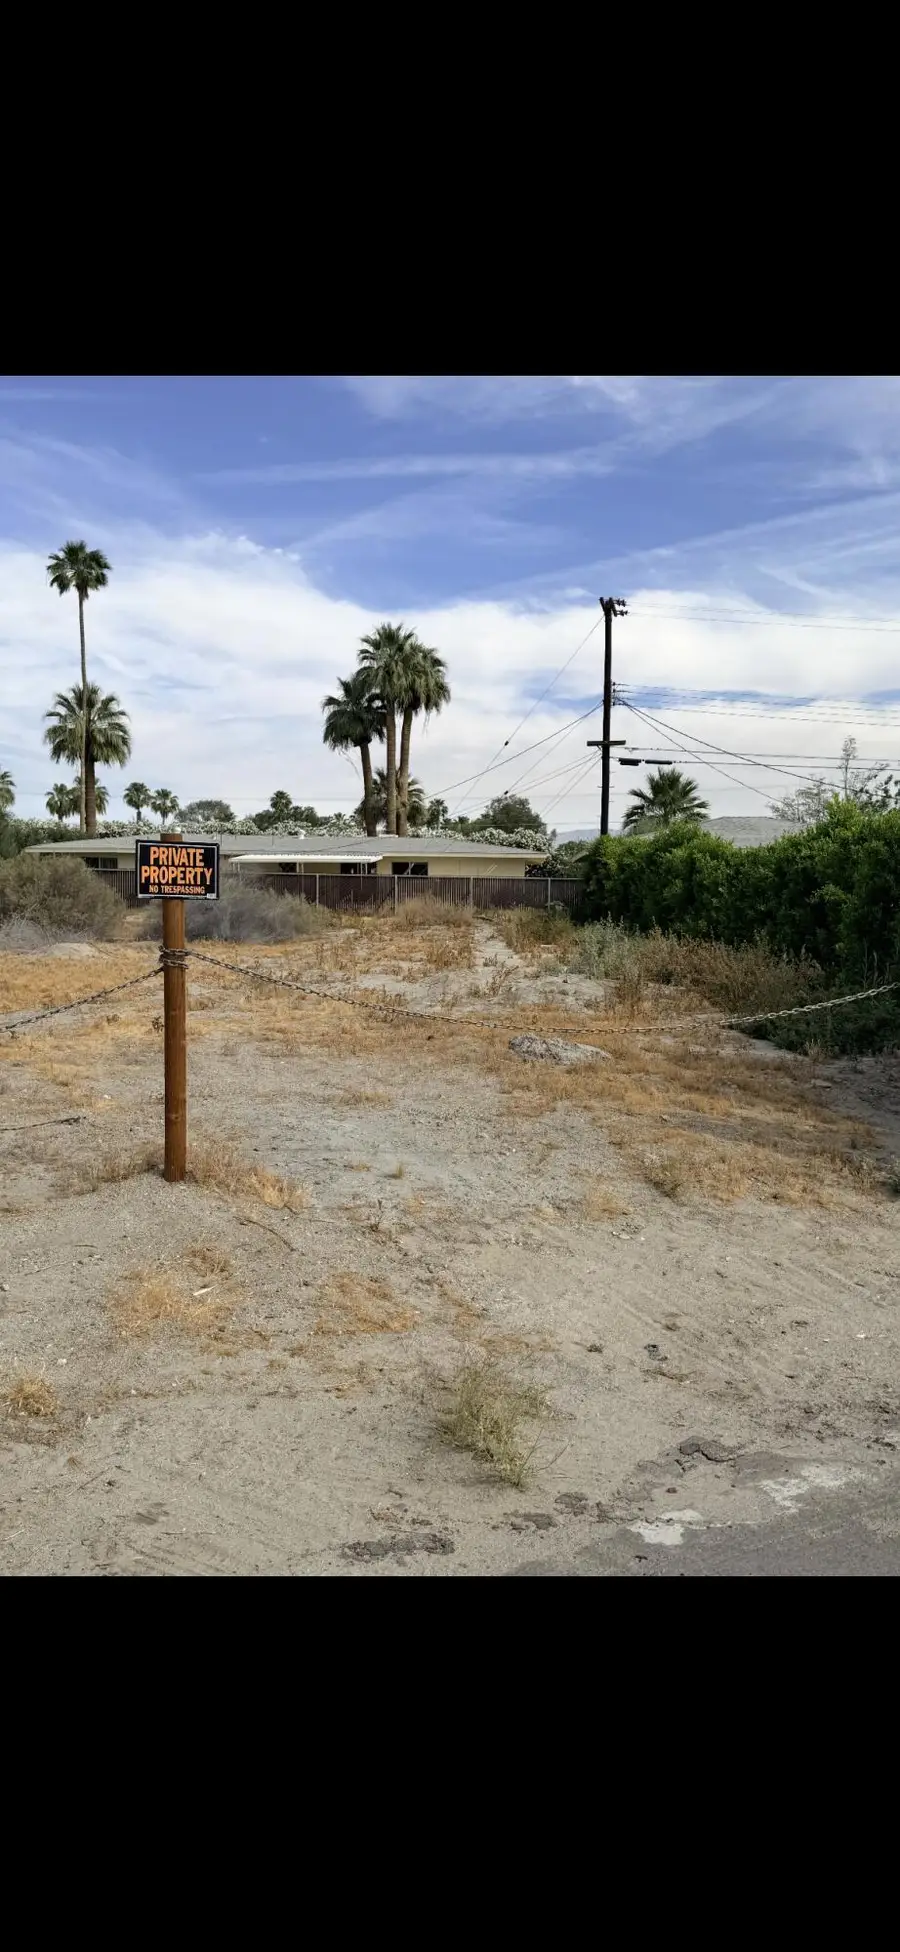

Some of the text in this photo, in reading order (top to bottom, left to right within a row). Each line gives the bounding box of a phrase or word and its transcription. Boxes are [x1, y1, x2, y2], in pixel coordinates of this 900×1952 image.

[149, 846, 205, 866] PRIVATE
[141, 865, 213, 885] PROPERTY
[149, 884, 206, 894] NO TRESPASSING
